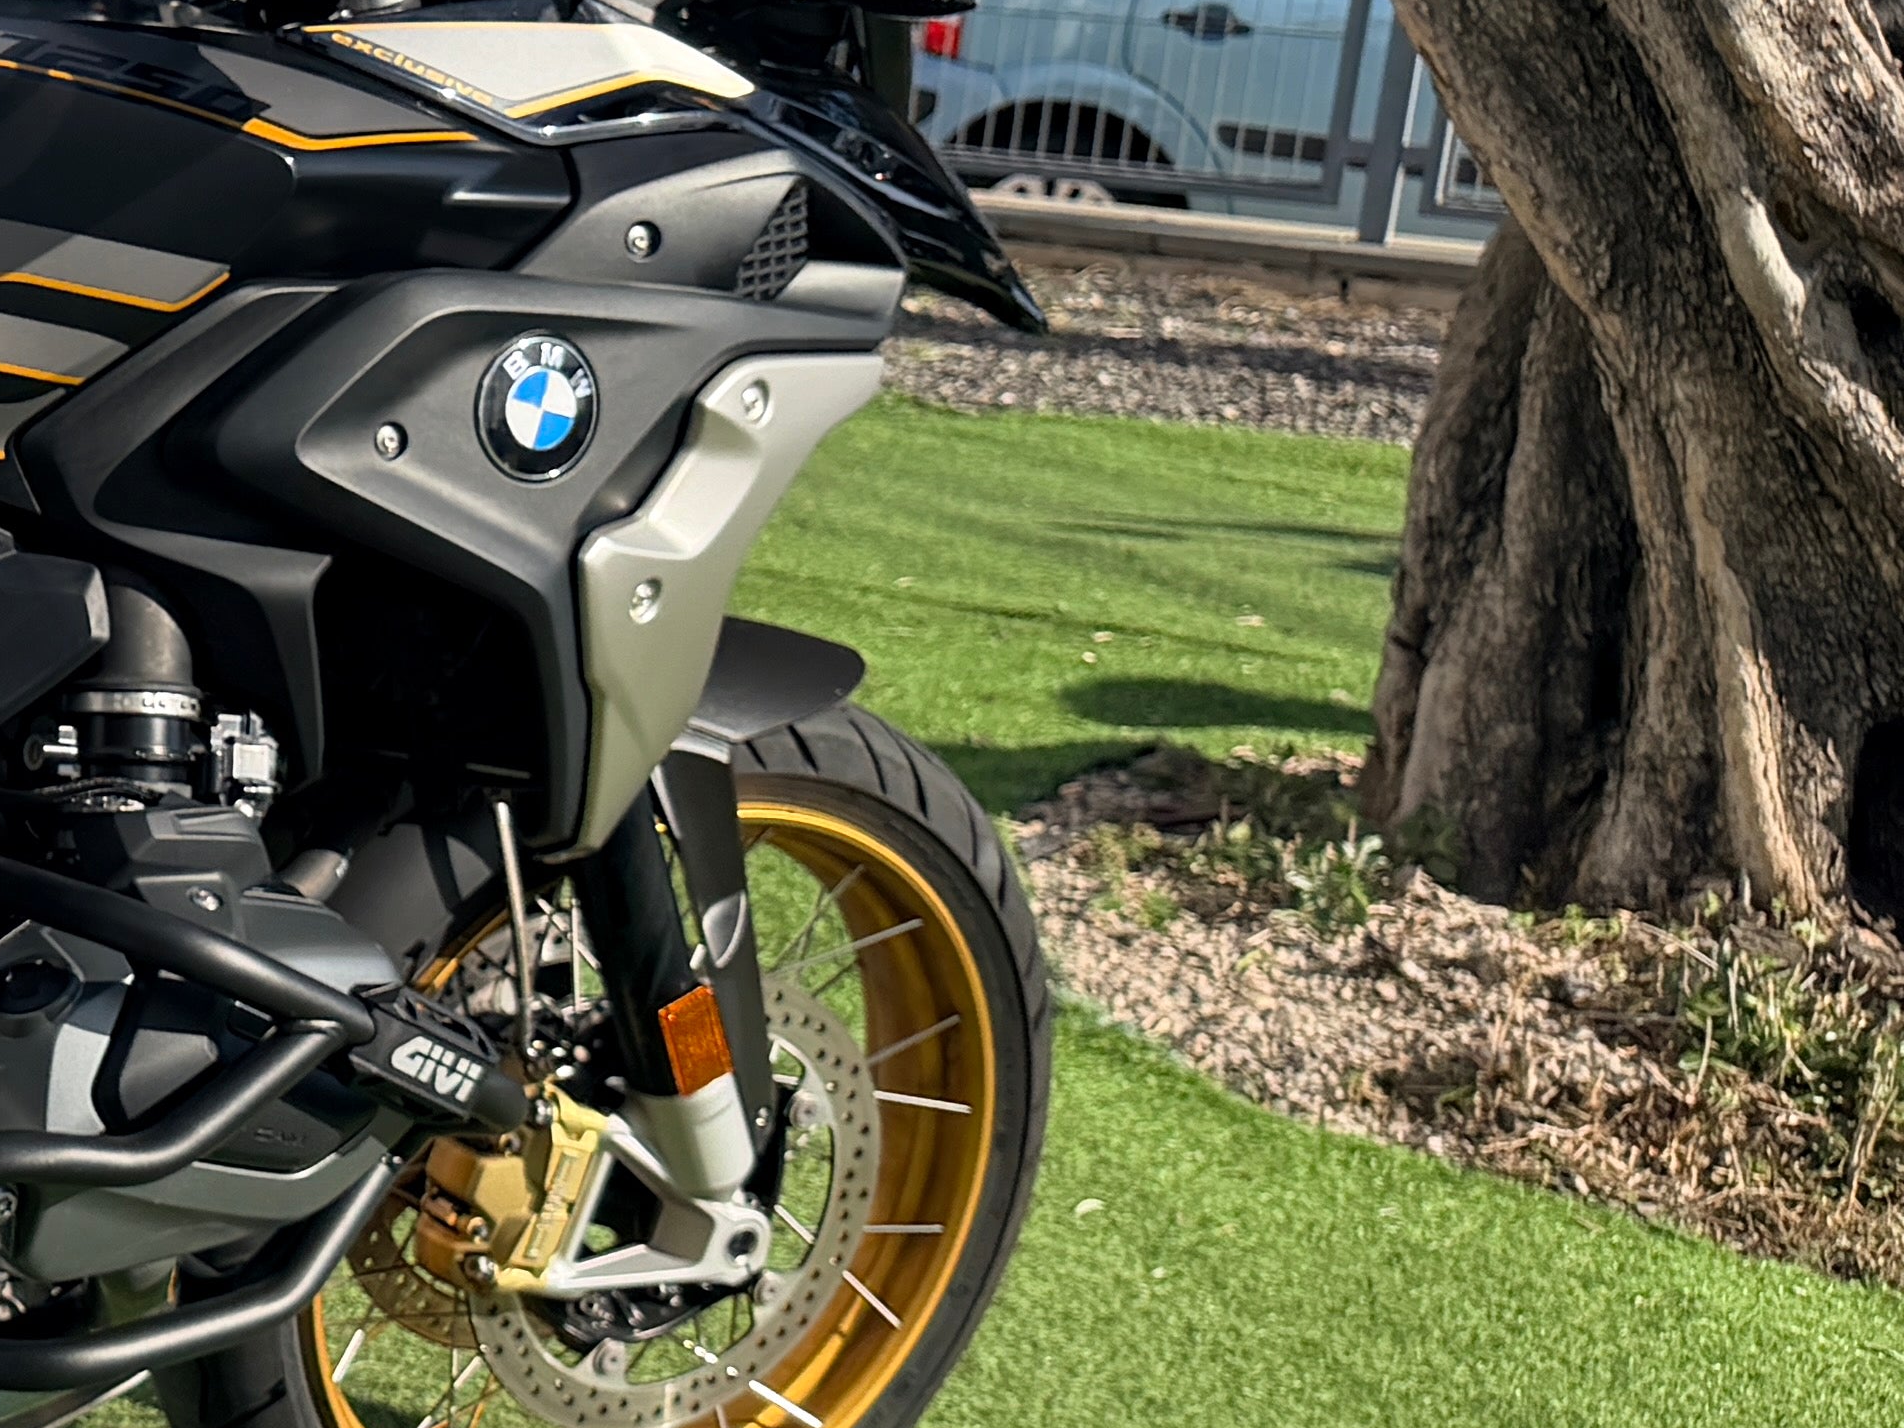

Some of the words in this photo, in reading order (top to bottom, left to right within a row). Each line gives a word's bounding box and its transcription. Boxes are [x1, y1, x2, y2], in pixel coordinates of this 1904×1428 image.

[330, 31, 495, 109] exclusive
[502, 342, 592, 398] BMW
[390, 1035, 484, 1104] GIVI
